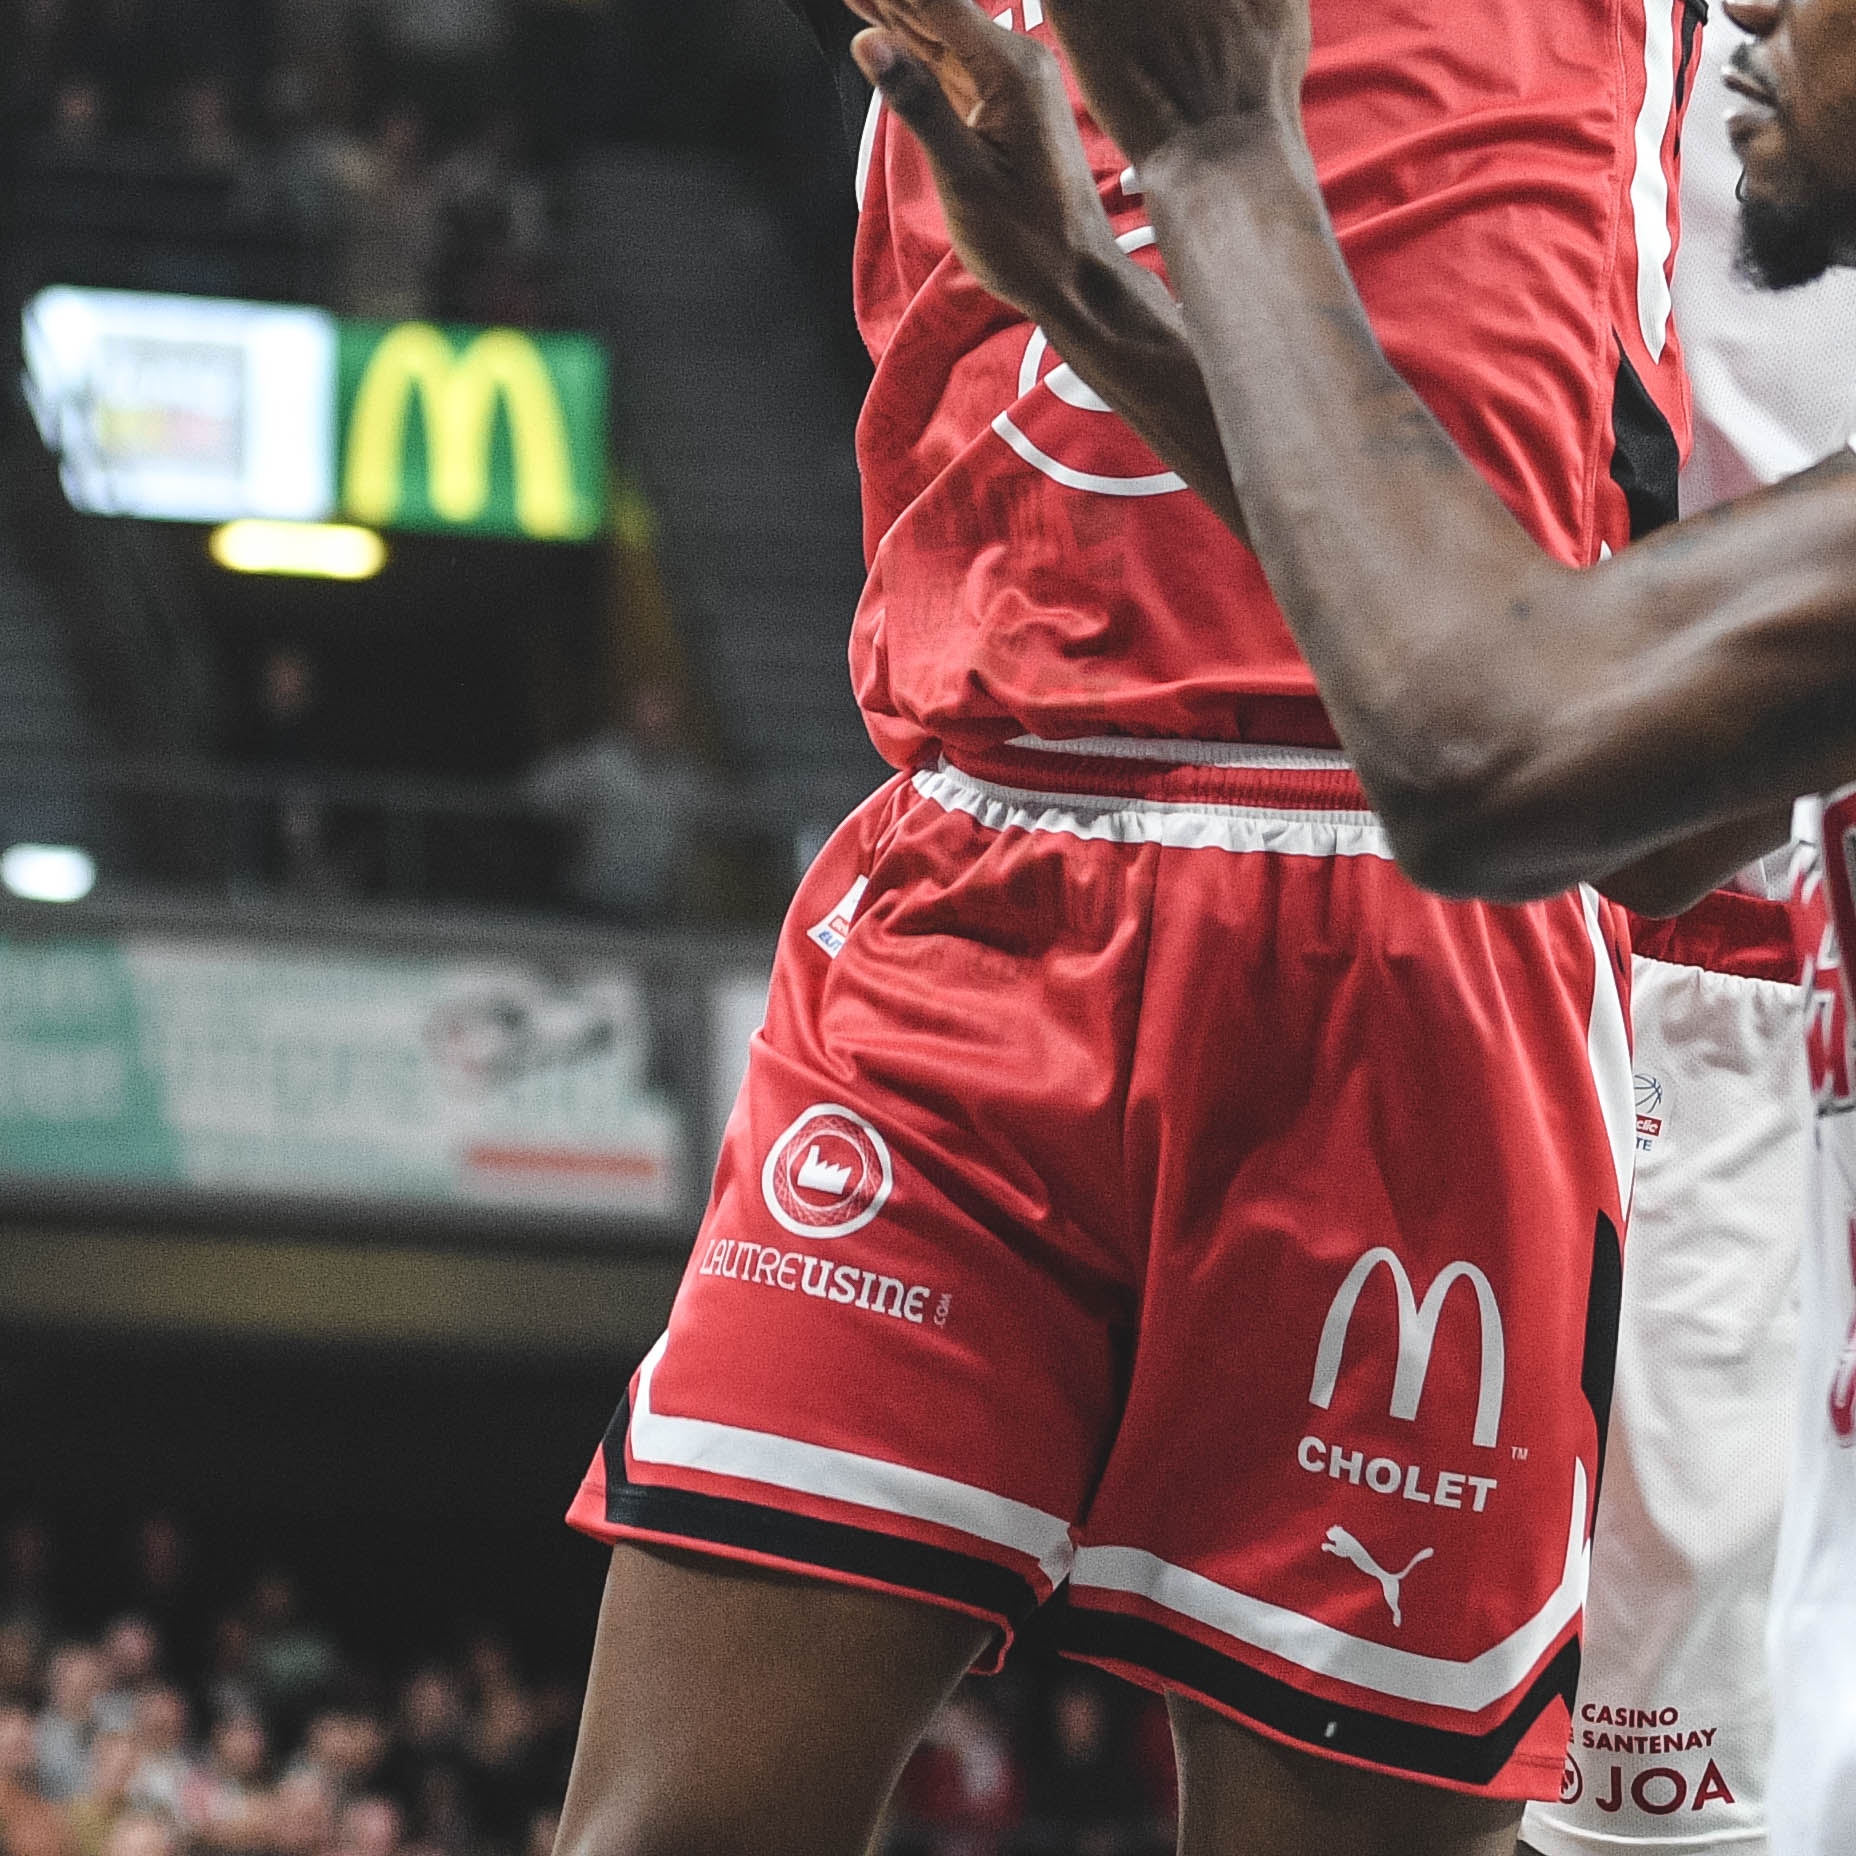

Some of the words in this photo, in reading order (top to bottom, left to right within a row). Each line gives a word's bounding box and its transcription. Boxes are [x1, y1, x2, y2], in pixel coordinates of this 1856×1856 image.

[1297, 1435, 1498, 1513] CHOLET
[1581, 1703, 1679, 1729] CASINO
[1582, 1727, 1718, 1754] SANTENAY
[1595, 1757, 1736, 1816] JOA
